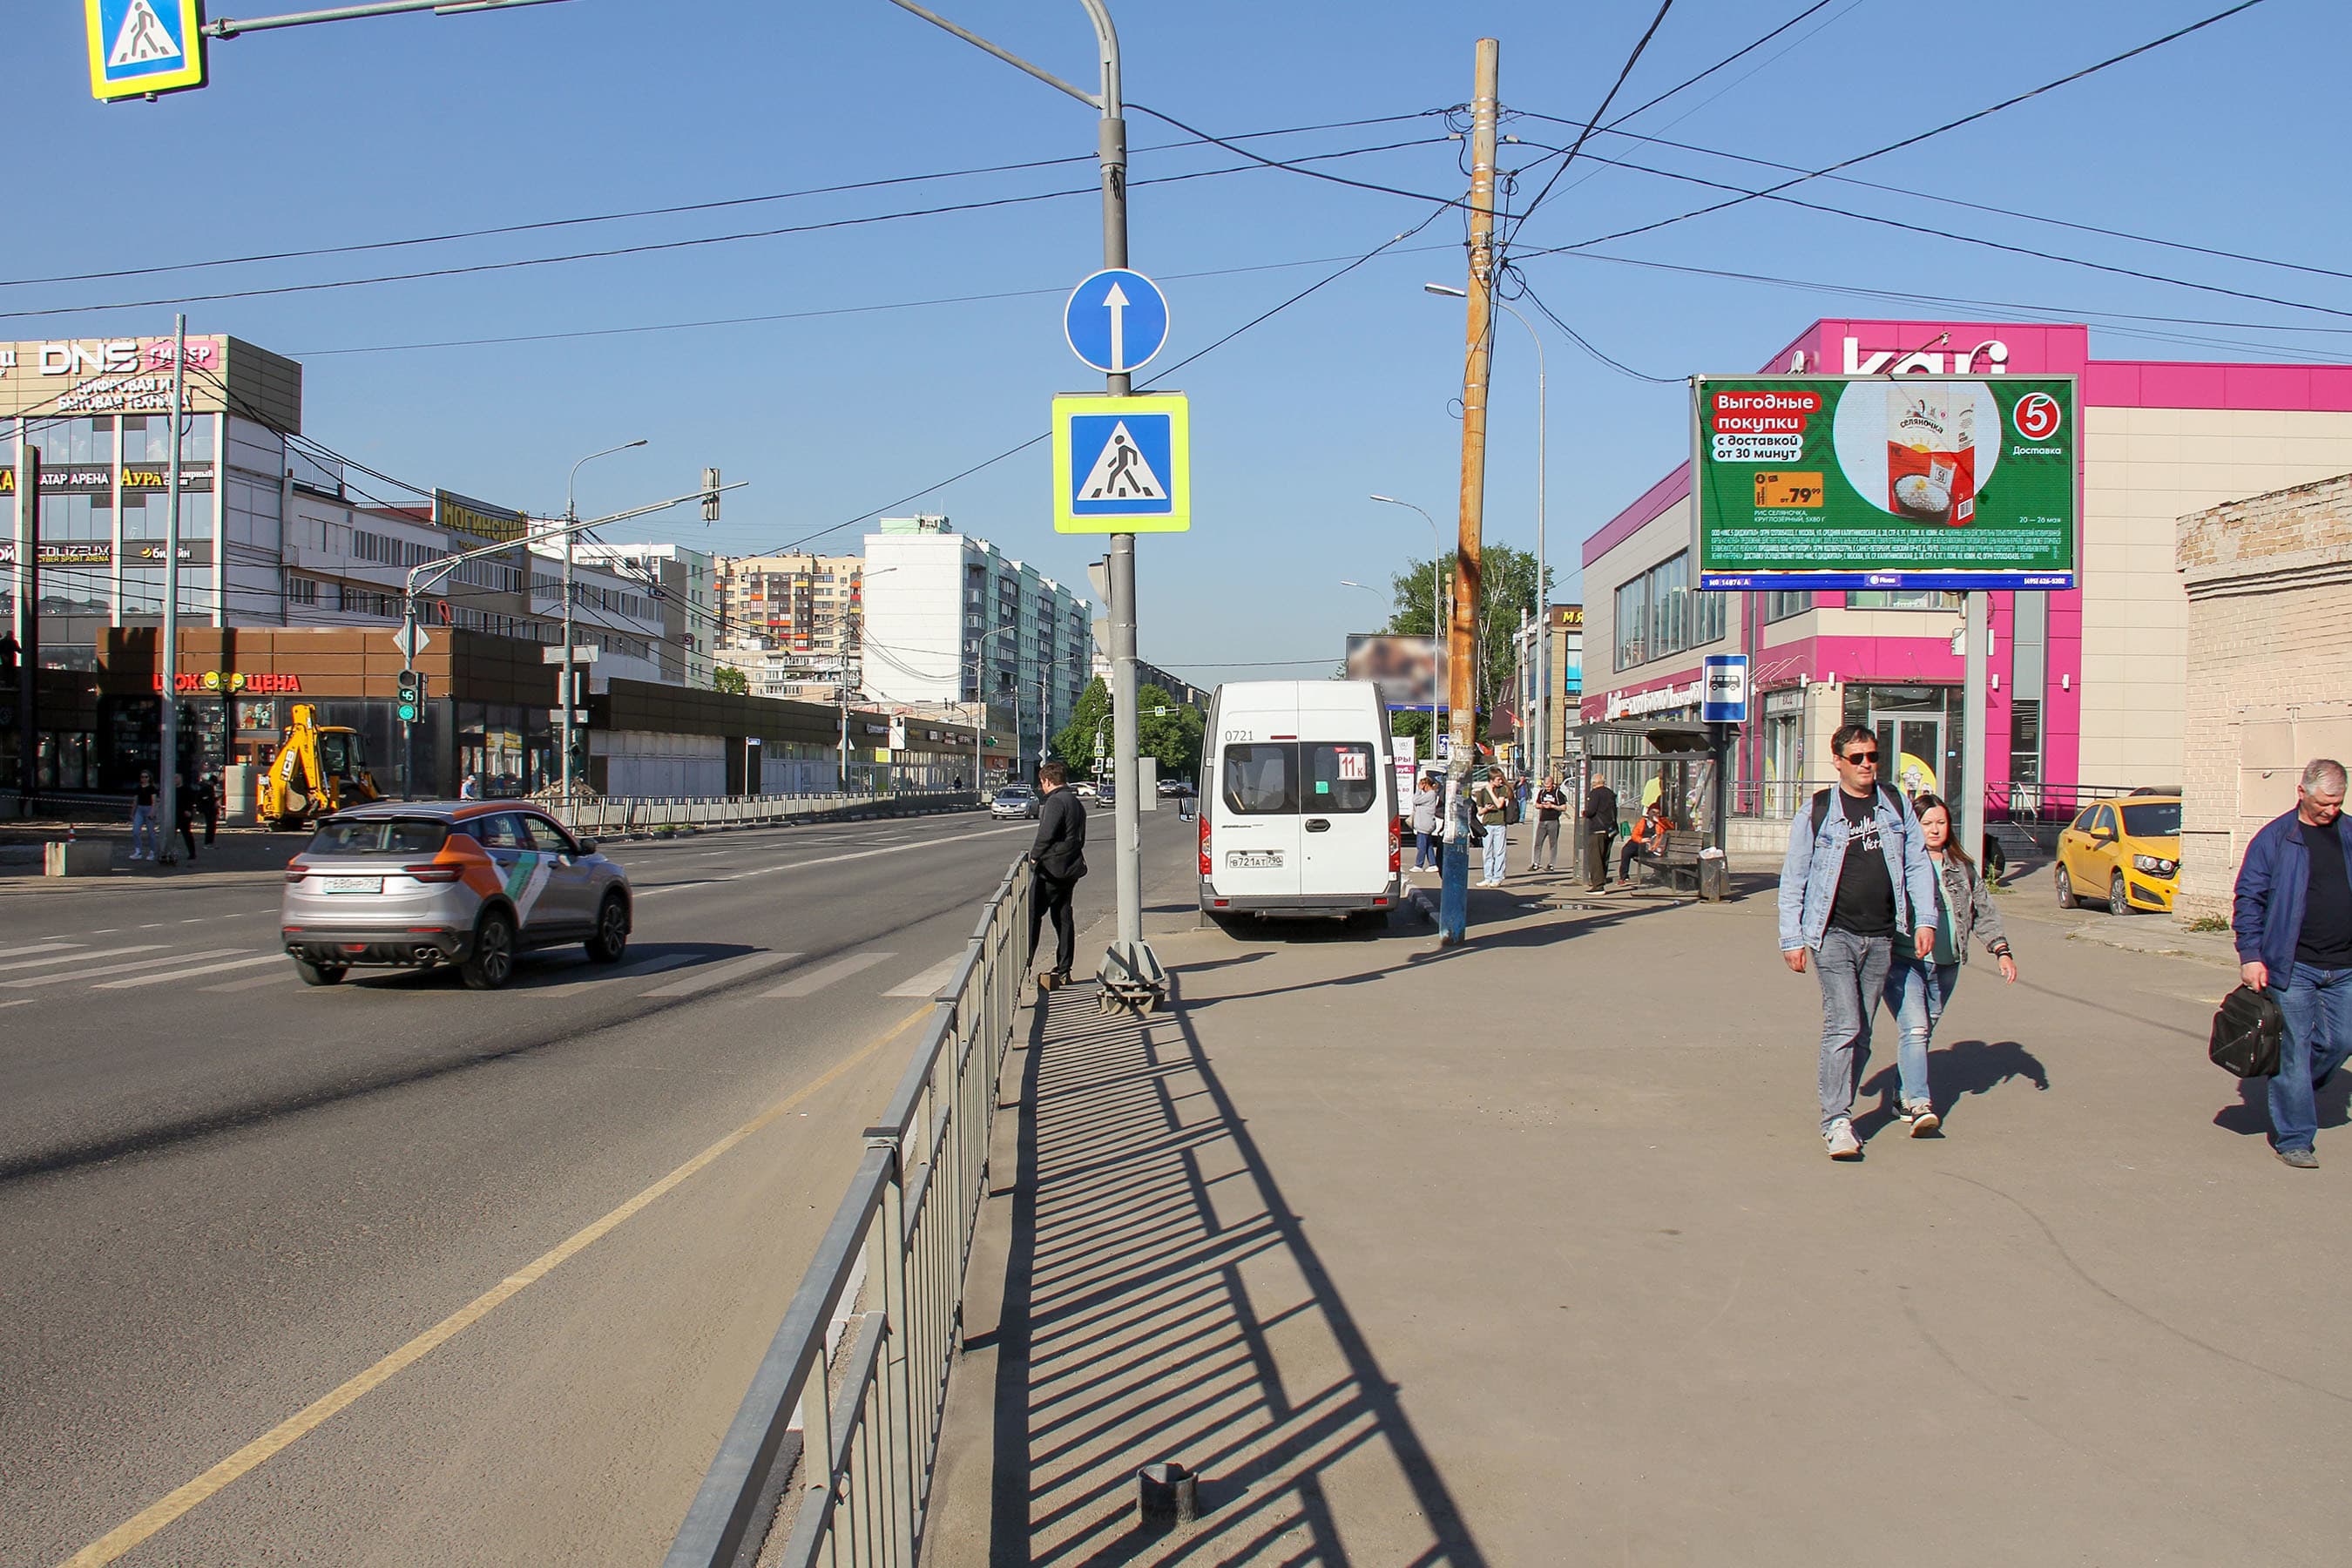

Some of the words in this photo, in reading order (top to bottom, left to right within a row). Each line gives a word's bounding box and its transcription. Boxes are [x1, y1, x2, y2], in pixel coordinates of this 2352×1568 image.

[39, 342, 138, 375] DNS
[150, 348, 211, 363] ГИЕР
[128, 393, 190, 409] ТЕХНИА
[1718, 394, 1814, 409] Выгодные
[1718, 417, 1799, 433] покупки
[1717, 437, 1725, 446] с
[1727, 436, 1798, 446] доставкой
[1717, 449, 1733, 458] от
[1735, 449, 1750, 458] 30
[1754, 450, 1797, 461] минут
[2013, 445, 2062, 456] Доставка
[71, 473, 110, 484] АРЕНА
[1789, 488, 1811, 503] 79
[152, 547, 192, 559] бийн
[246, 674, 301, 694] ЦЕНА
[1225, 730, 1254, 741] 0721
